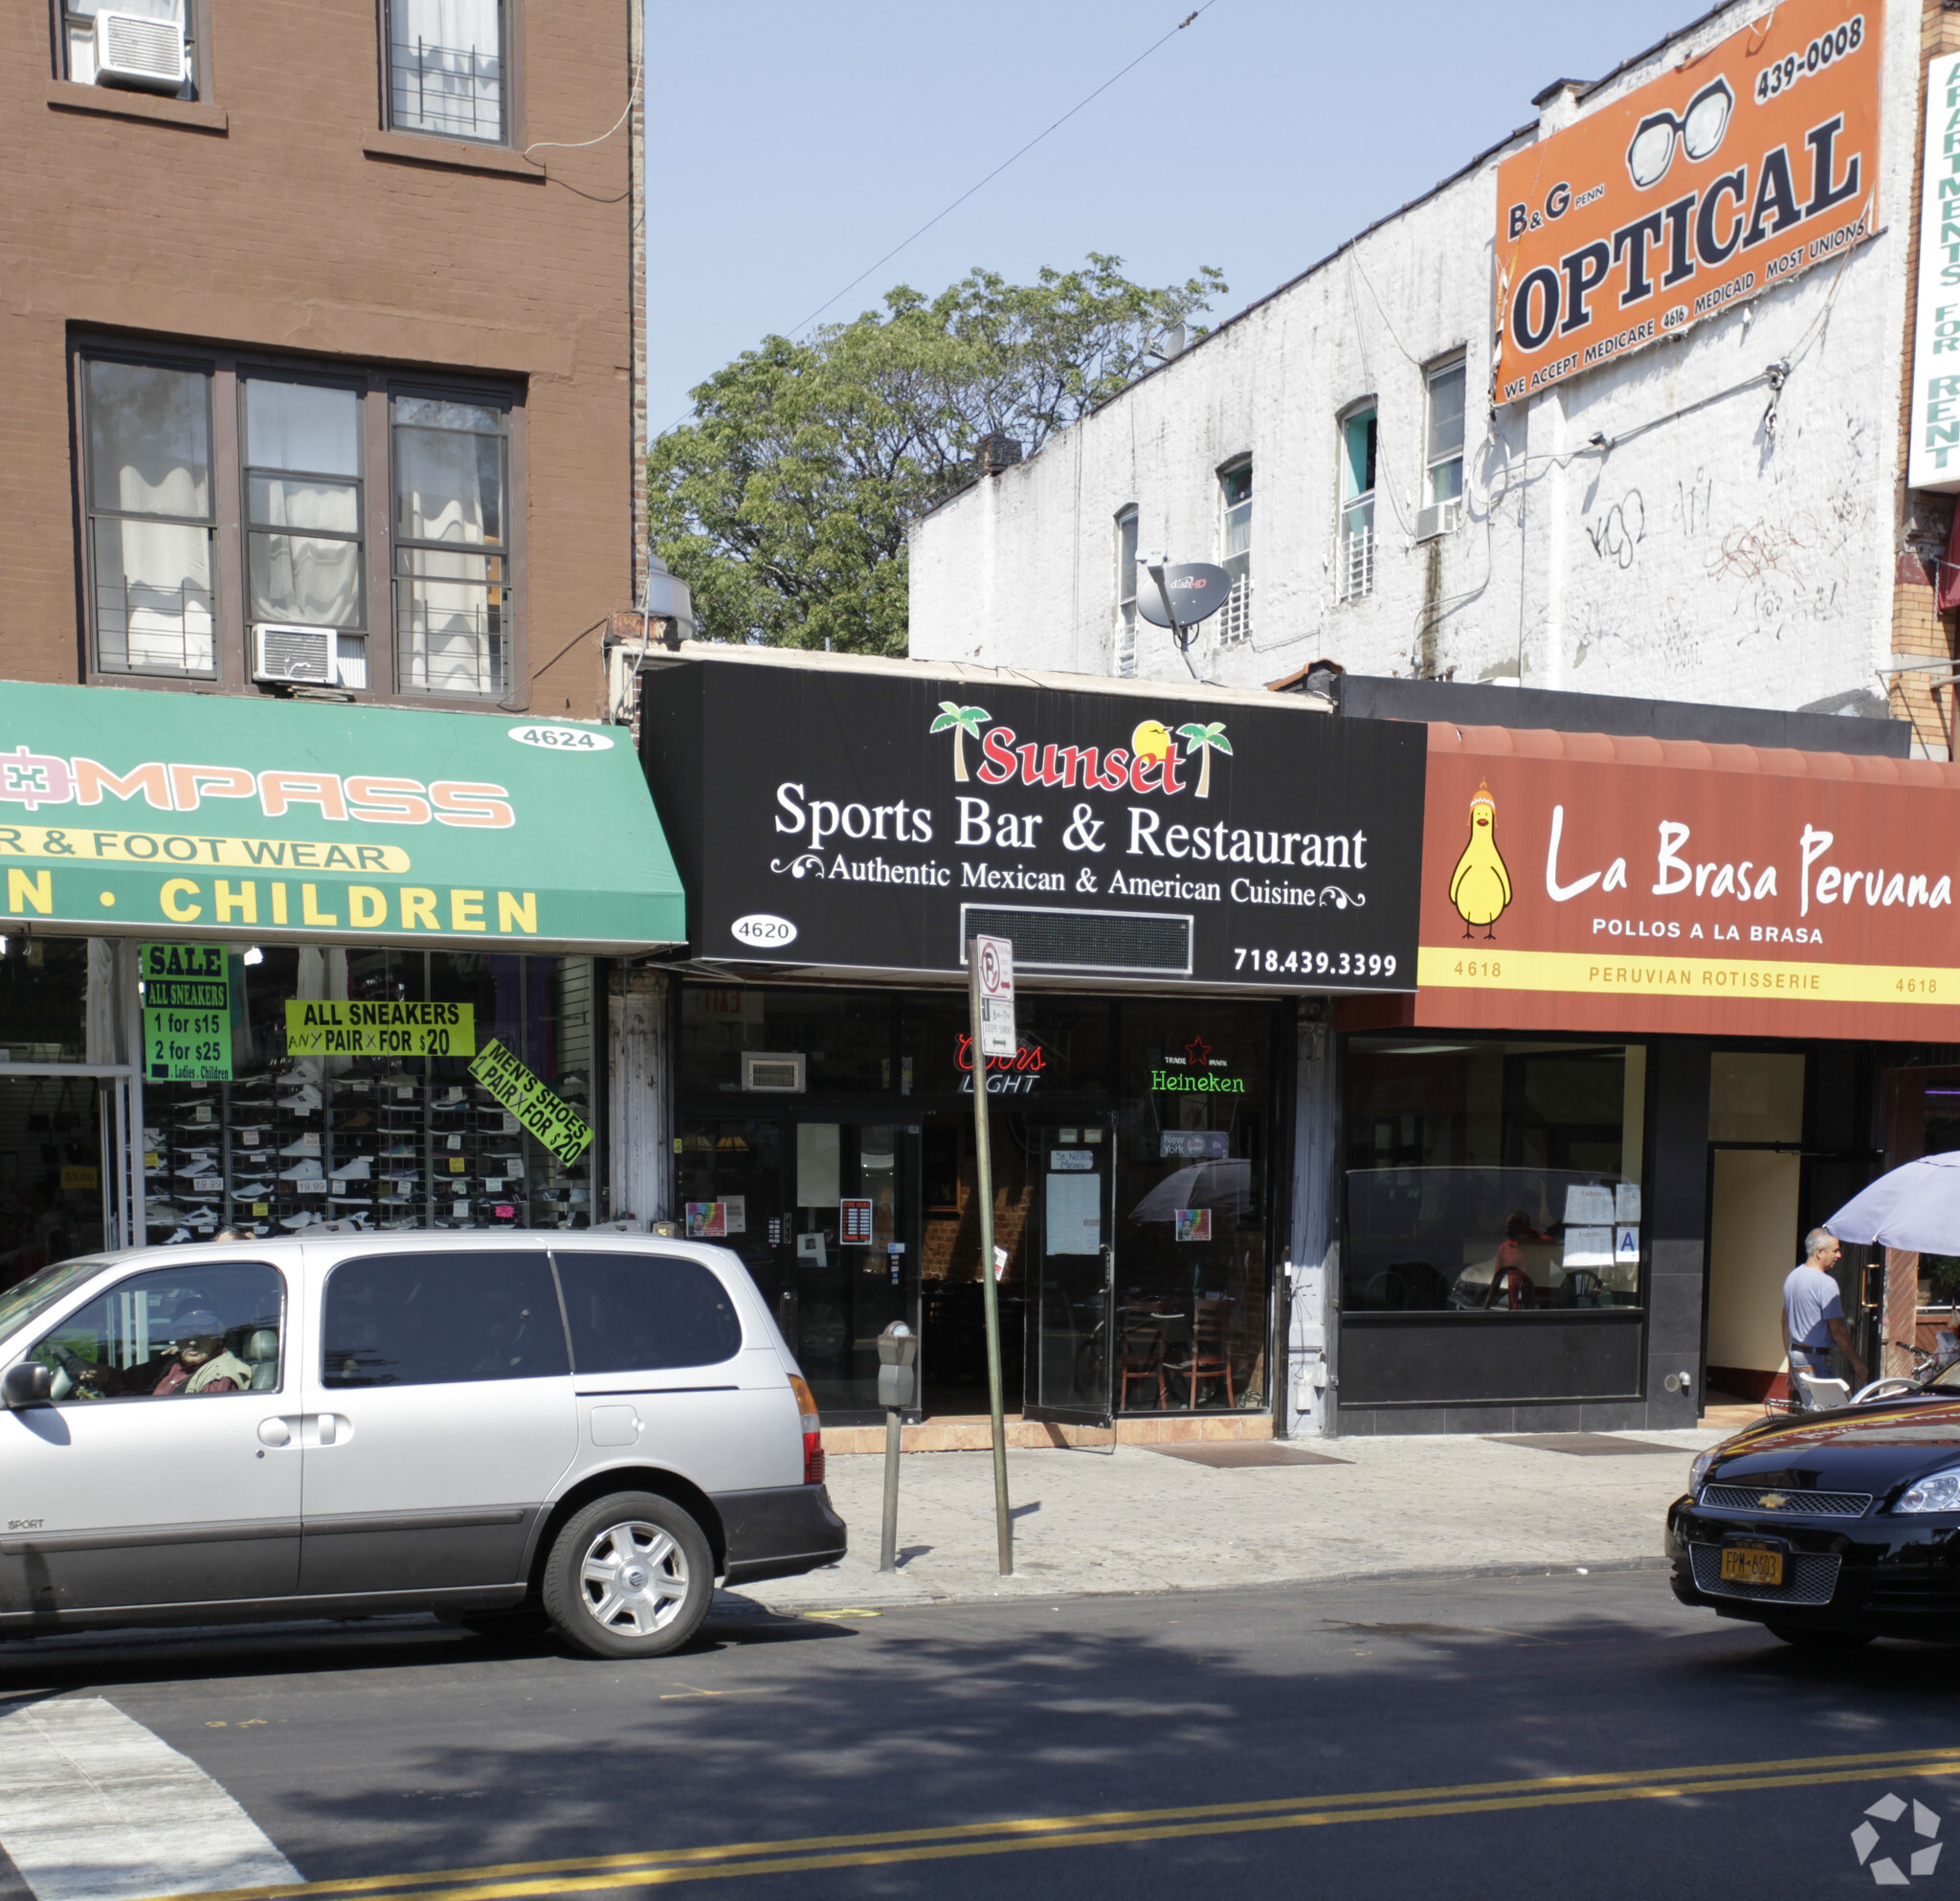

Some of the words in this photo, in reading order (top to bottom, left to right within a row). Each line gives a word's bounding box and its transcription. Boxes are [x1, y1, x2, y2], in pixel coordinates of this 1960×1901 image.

[1757, 16, 1863, 101] 439-0008
[1509, 204, 1526, 239] B
[1530, 212, 1543, 230] &
[1546, 183, 1570, 218] G
[1575, 185, 1605, 209] PENN
[1512, 116, 1860, 350] OPTICAL
[1504, 378, 1526, 400] WE
[1531, 355, 1578, 389] ACCEPT
[1584, 318, 1655, 365] MEDICARE
[1663, 309, 1685, 328] 4616
[1694, 272, 1755, 315] MEDICAID
[1766, 248, 1804, 279] MOST
[1809, 220, 1866, 258] UNIONS
[1932, 302, 1960, 355] FOR
[1925, 374, 1960, 469] RENT
[523, 729, 594, 749] 4624
[976, 727, 1187, 795] Sunset
[775, 782, 933, 850] Sports
[955, 796, 1043, 848] Bar
[1062, 803, 1106, 852] &
[1125, 807, 1368, 868] Restaurant
[43, 830, 77, 856] &
[93, 832, 227, 862] FOOT
[242, 839, 390, 871] WEAR
[1546, 804, 1627, 903] La
[1652, 819, 1777, 902] Brasa
[828, 854, 951, 886] Authentic
[961, 861, 1065, 891] Mexican
[1076, 867, 1098, 893] &
[1108, 870, 1220, 901] American
[1231, 878, 1316, 906] Cuisine
[160, 878, 538, 933] CHILDREN
[738, 922, 790, 939] 4620
[1592, 919, 1682, 938] POLLOS
[1690, 923, 1704, 939] A
[1714, 924, 1740, 940] LA
[1750, 926, 1823, 944] BRASA
[149, 946, 221, 976] SALE
[1234, 949, 1397, 976] 718.439.3399
[1454, 961, 1502, 977] 4618
[1589, 967, 1692, 985] PERUVIAN
[1703, 971, 1820, 990] ROTISSERIE
[1896, 978, 1937, 994] 4618
[148, 984, 168, 1005] ALL
[170, 984, 225, 1008] SNEAKERS
[154, 1013, 161, 1032] 1
[168, 1013, 189, 1033] for
[194, 1015, 220, 1034] $15
[303, 1003, 343, 1026] ALL
[349, 1003, 459, 1026] SNEAKERS
[155, 1040, 164, 1060] 2
[169, 1040, 190, 1060] for
[195, 1041, 221, 1061] $25
[325, 1029, 363, 1051] PAIR
[379, 1030, 412, 1051] FOR
[419, 1028, 450, 1056] $20
[174, 1064, 195, 1080] Ladies
[200, 1063, 229, 1081] Children
[1165, 1056, 1187, 1064] TRADE
[488, 1043, 538, 1092] MEN'S
[536, 1089, 588, 1140] SHOES
[963, 1074, 1040, 1093] LGHT
[1150, 1070, 1245, 1092] Heineken
[480, 1064, 518, 1105] PAIR
[520, 1102, 553, 1137] FOR
[549, 1132, 582, 1164] $20
[1164, 1134, 1185, 1144] New
[1164, 1145, 1185, 1154] York
[195, 1179, 222, 1190] 19.99
[300, 1181, 325, 1192] 19.99
[1620, 1232, 1636, 1252] A
[8, 1518, 45, 1530] SPORT
